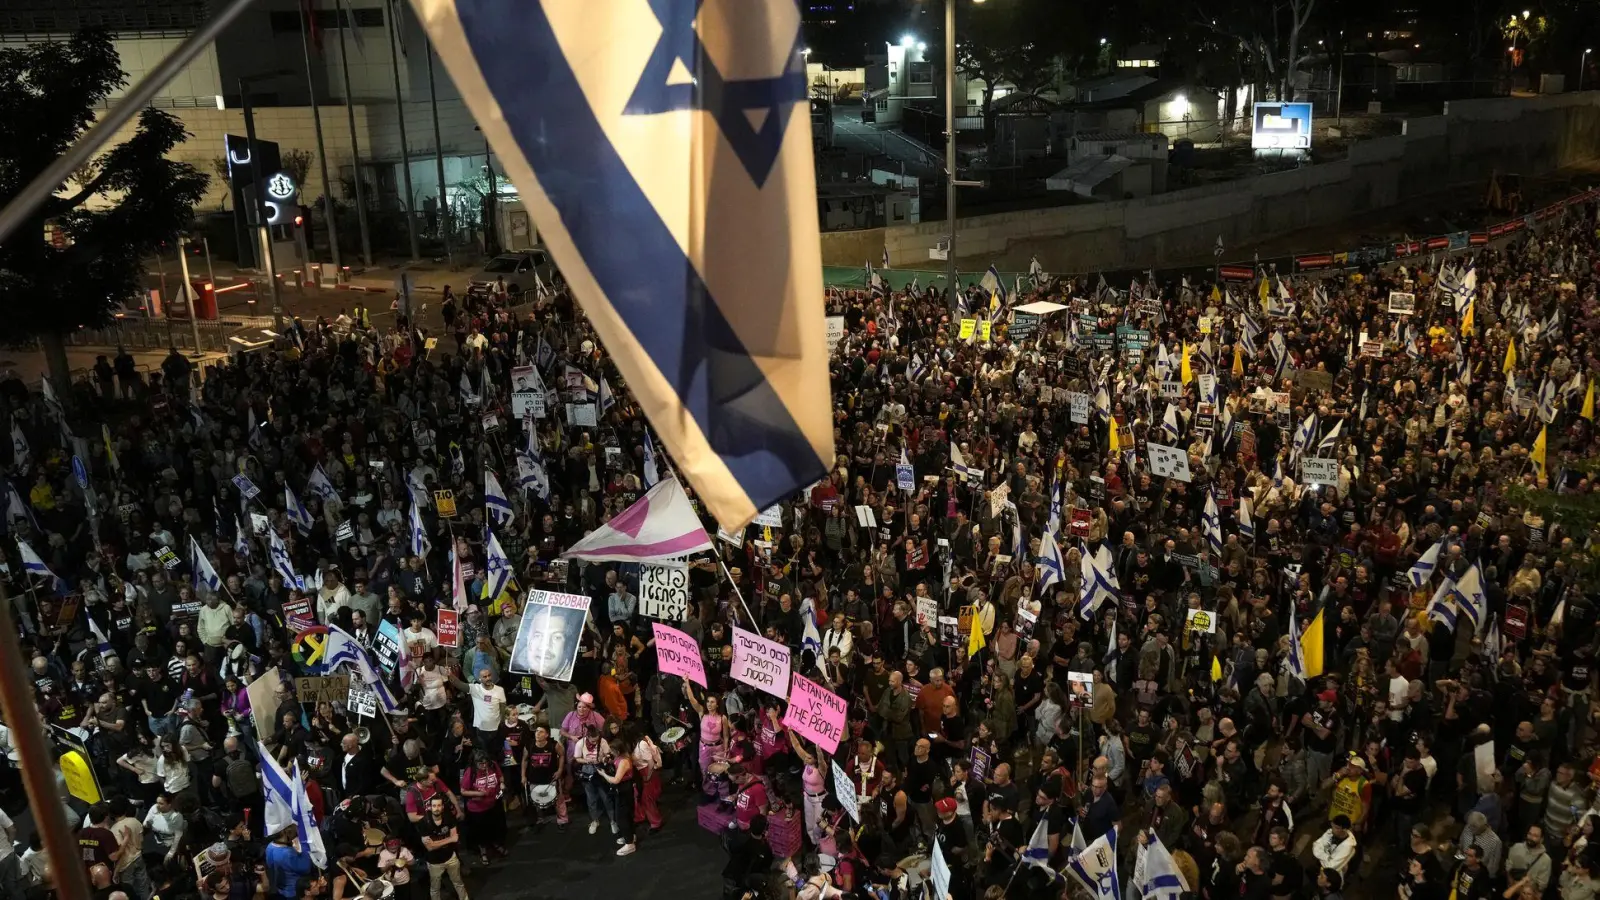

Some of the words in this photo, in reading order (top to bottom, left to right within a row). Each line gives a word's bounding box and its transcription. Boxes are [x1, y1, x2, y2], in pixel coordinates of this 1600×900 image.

[1162, 384, 1177, 392] 414
[436, 491, 451, 499] 7.10
[529, 591, 547, 603] BIBI
[548, 593, 590, 608] ESCOBAR
[302, 678, 311, 689] a
[794, 675, 845, 715] NETANYAHU
[808, 698, 823, 717] VS.
[789, 704, 808, 725] THE
[808, 715, 841, 742] PEOPLE
